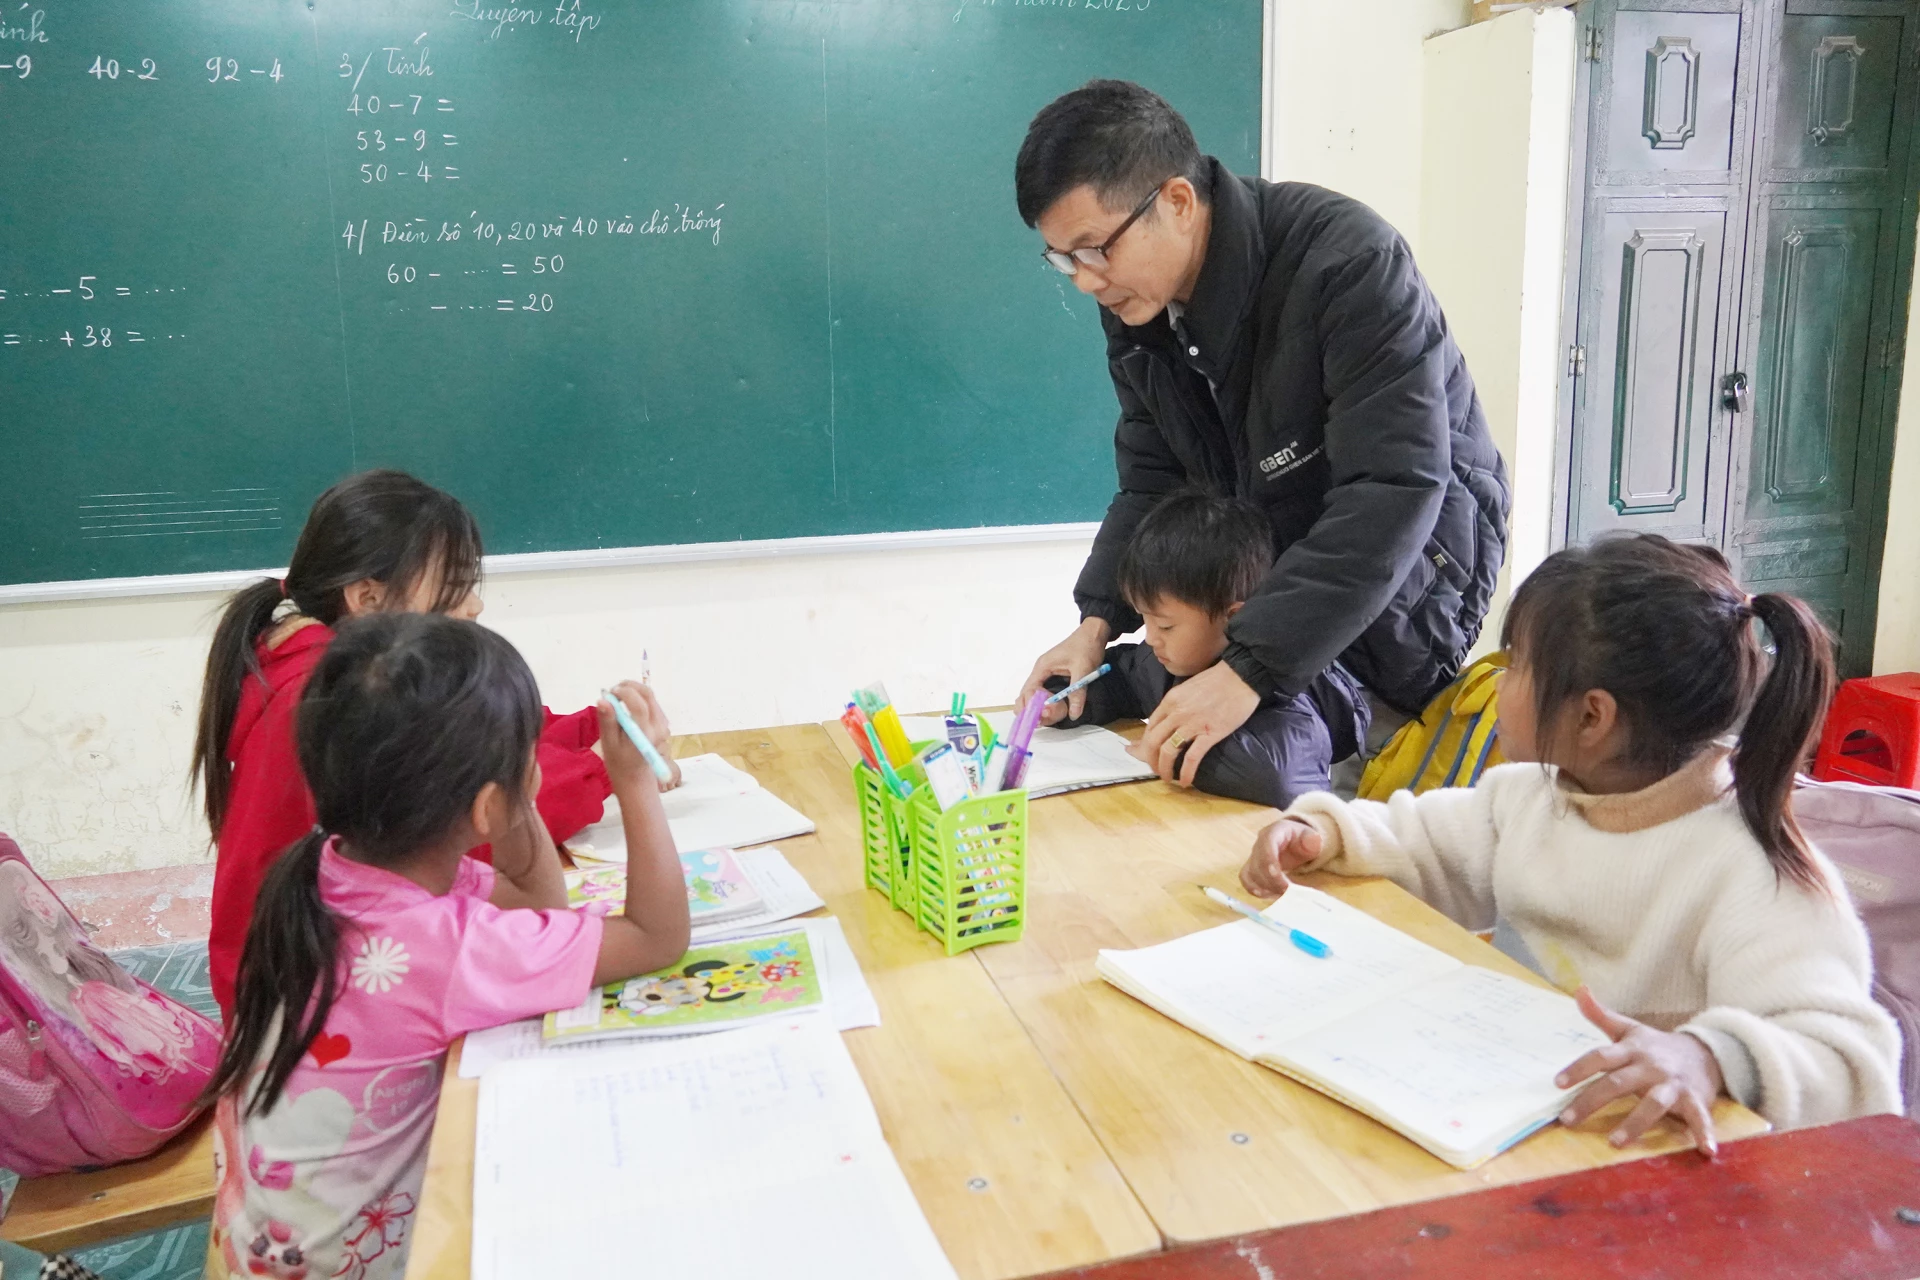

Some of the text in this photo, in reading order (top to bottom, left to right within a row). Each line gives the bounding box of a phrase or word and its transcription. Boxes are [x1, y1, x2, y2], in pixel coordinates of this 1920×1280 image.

[0, 2, 49, 43] ính
[382, 32, 434, 76] Tính
[508, 221, 536, 241] 20
[542, 215, 567, 238] và
[571, 216, 598, 237] 40
[607, 214, 634, 235] vào
[673, 203, 725, 246] trống
[387, 263, 417, 284] 60
[532, 254, 564, 274] 50
[522, 293, 554, 312] 20
